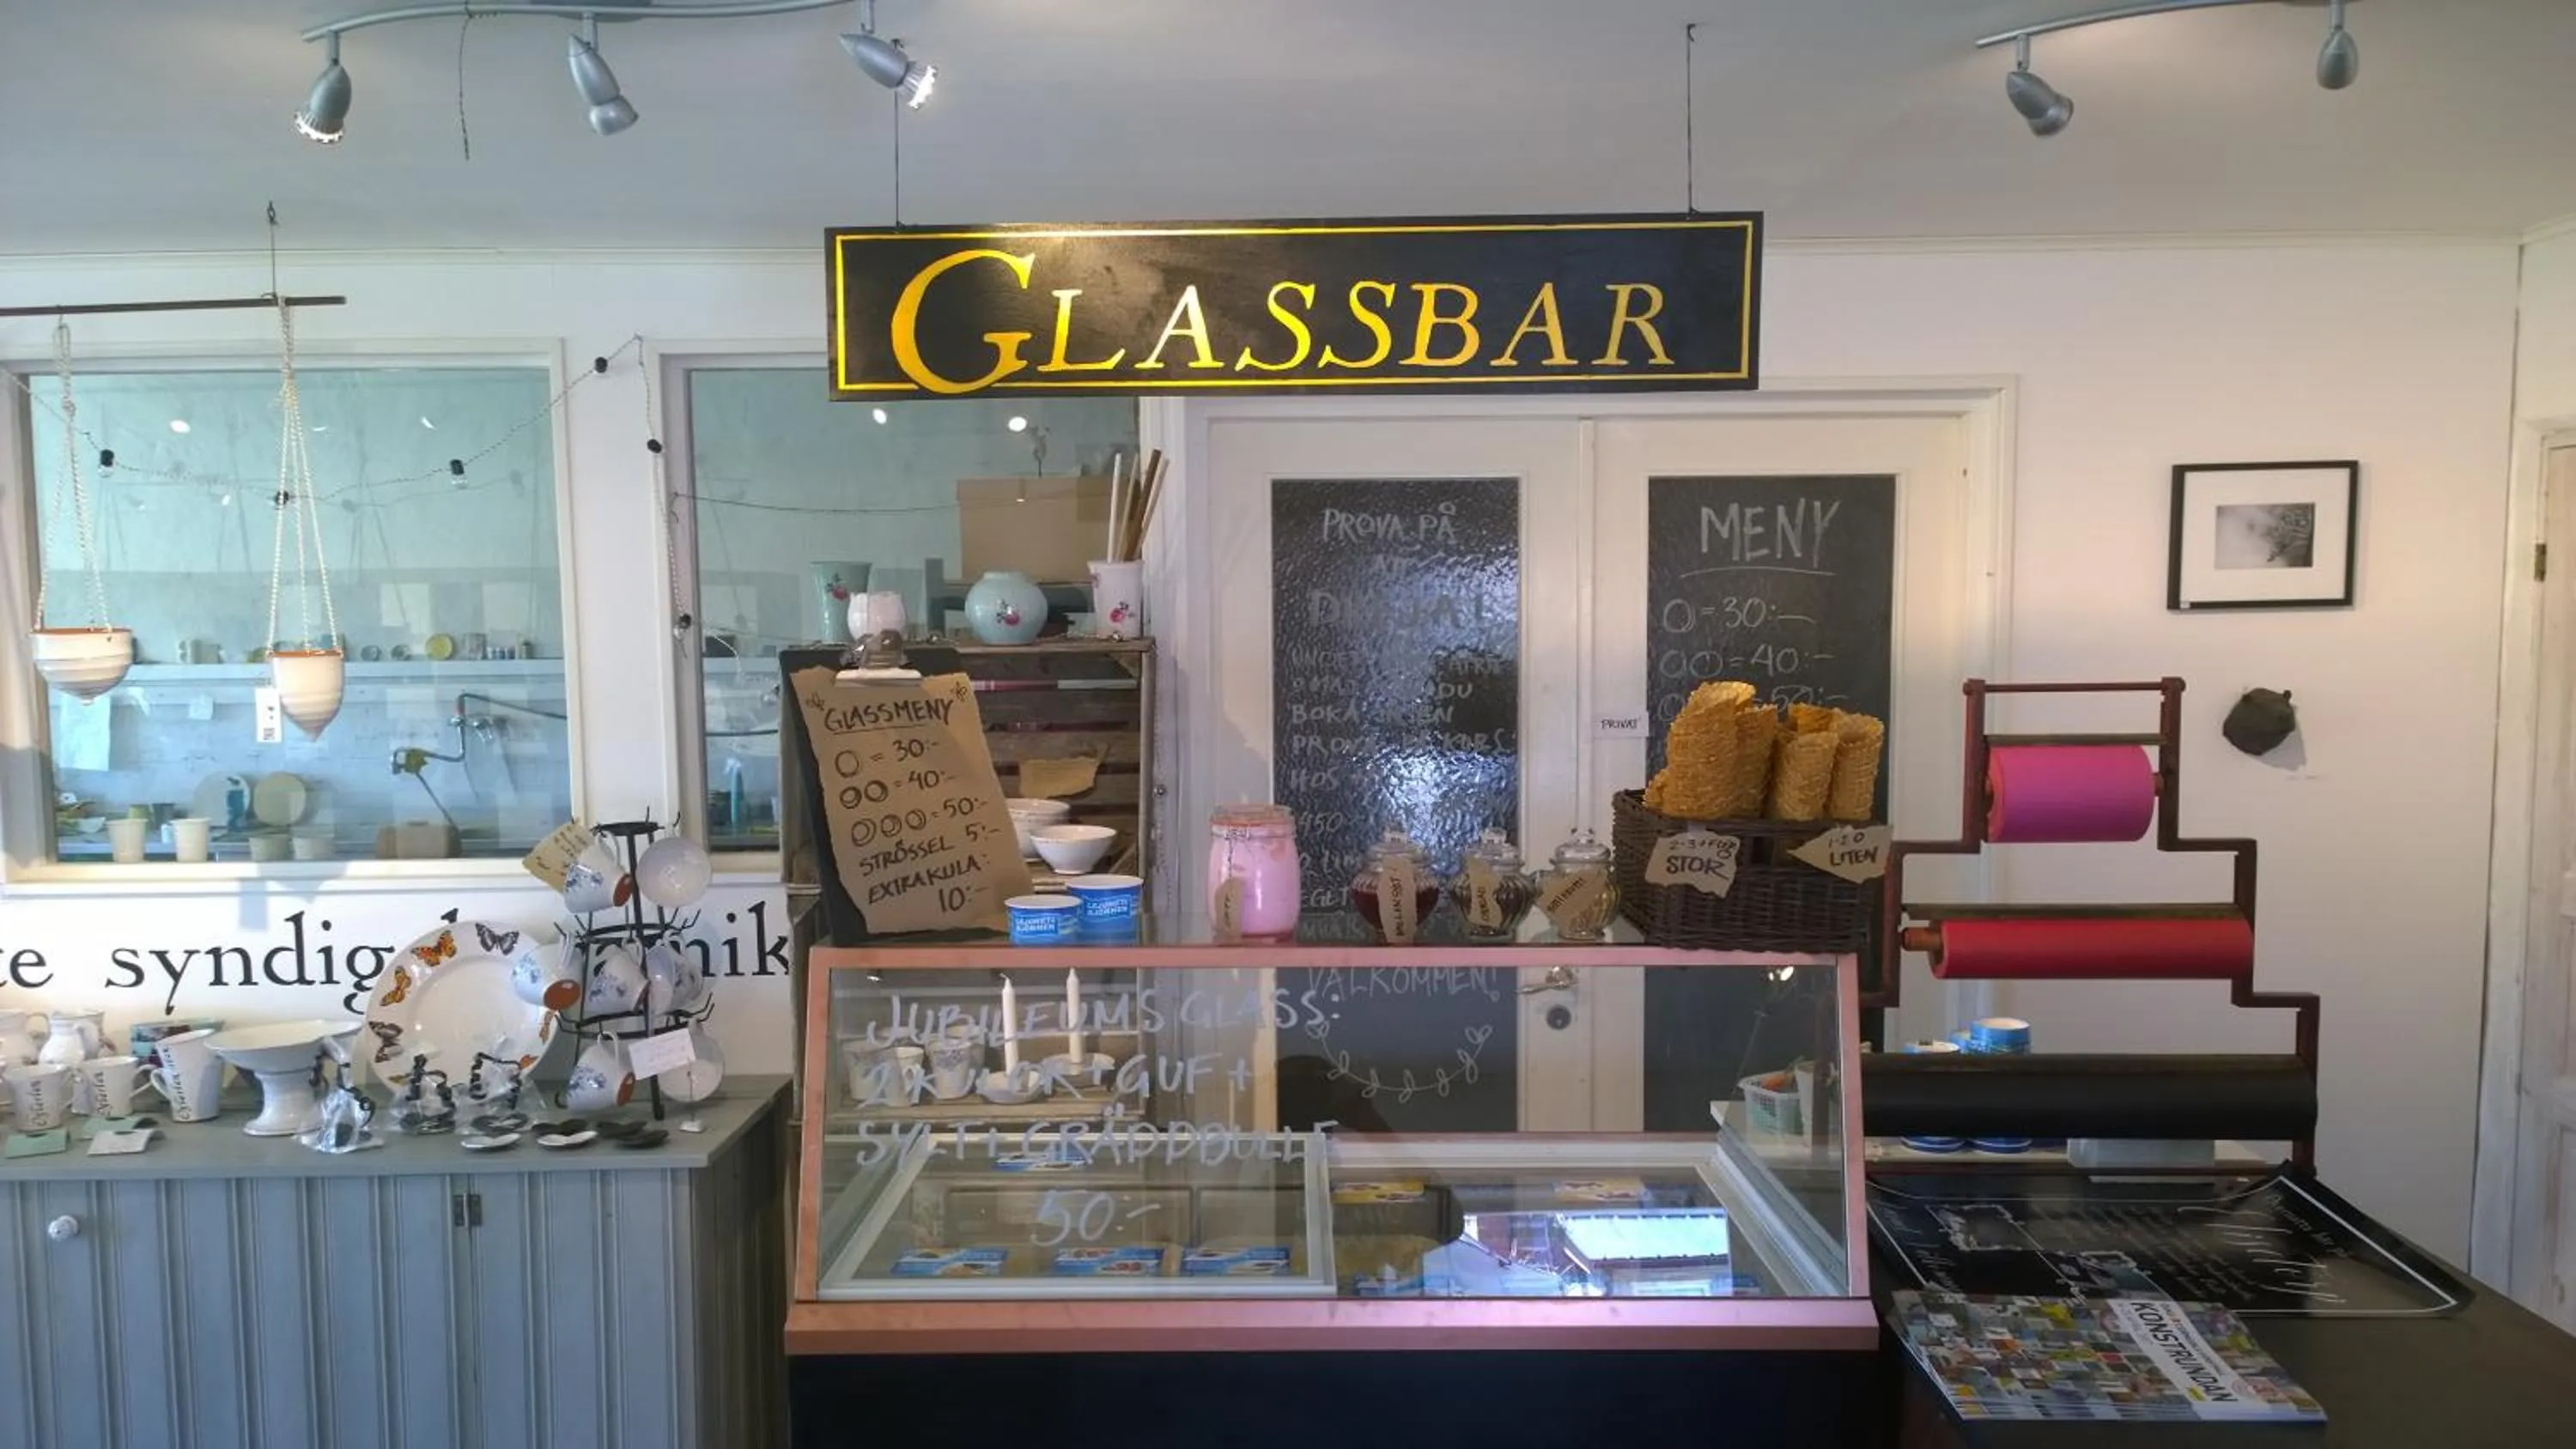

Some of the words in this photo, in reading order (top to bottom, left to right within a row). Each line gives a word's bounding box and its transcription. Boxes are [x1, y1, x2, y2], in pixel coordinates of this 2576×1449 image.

[890, 249, 1674, 395] GLASSBAR
[1322, 507, 1407, 543] PROVA
[1419, 501, 1460, 544] PÅ
[1699, 497, 1841, 568] MENY
[1437, 682, 1474, 700] DU
[823, 696, 954, 732] GLASSMENY
[1291, 700, 1359, 725] BOKA
[943, 797, 988, 820] 50:-
[860, 838, 956, 877] STRÖSSEL
[965, 822, 1003, 843] 5:-
[1666, 854, 1729, 882] STOR
[1829, 845, 1879, 869] LITEN
[938, 884, 991, 913] 10:-
[866, 989, 1165, 1046] JUBILEUMS
[1030, 1189, 1163, 1247] 50:-
[2129, 1300, 2239, 1403] KONSTRUNDAN
